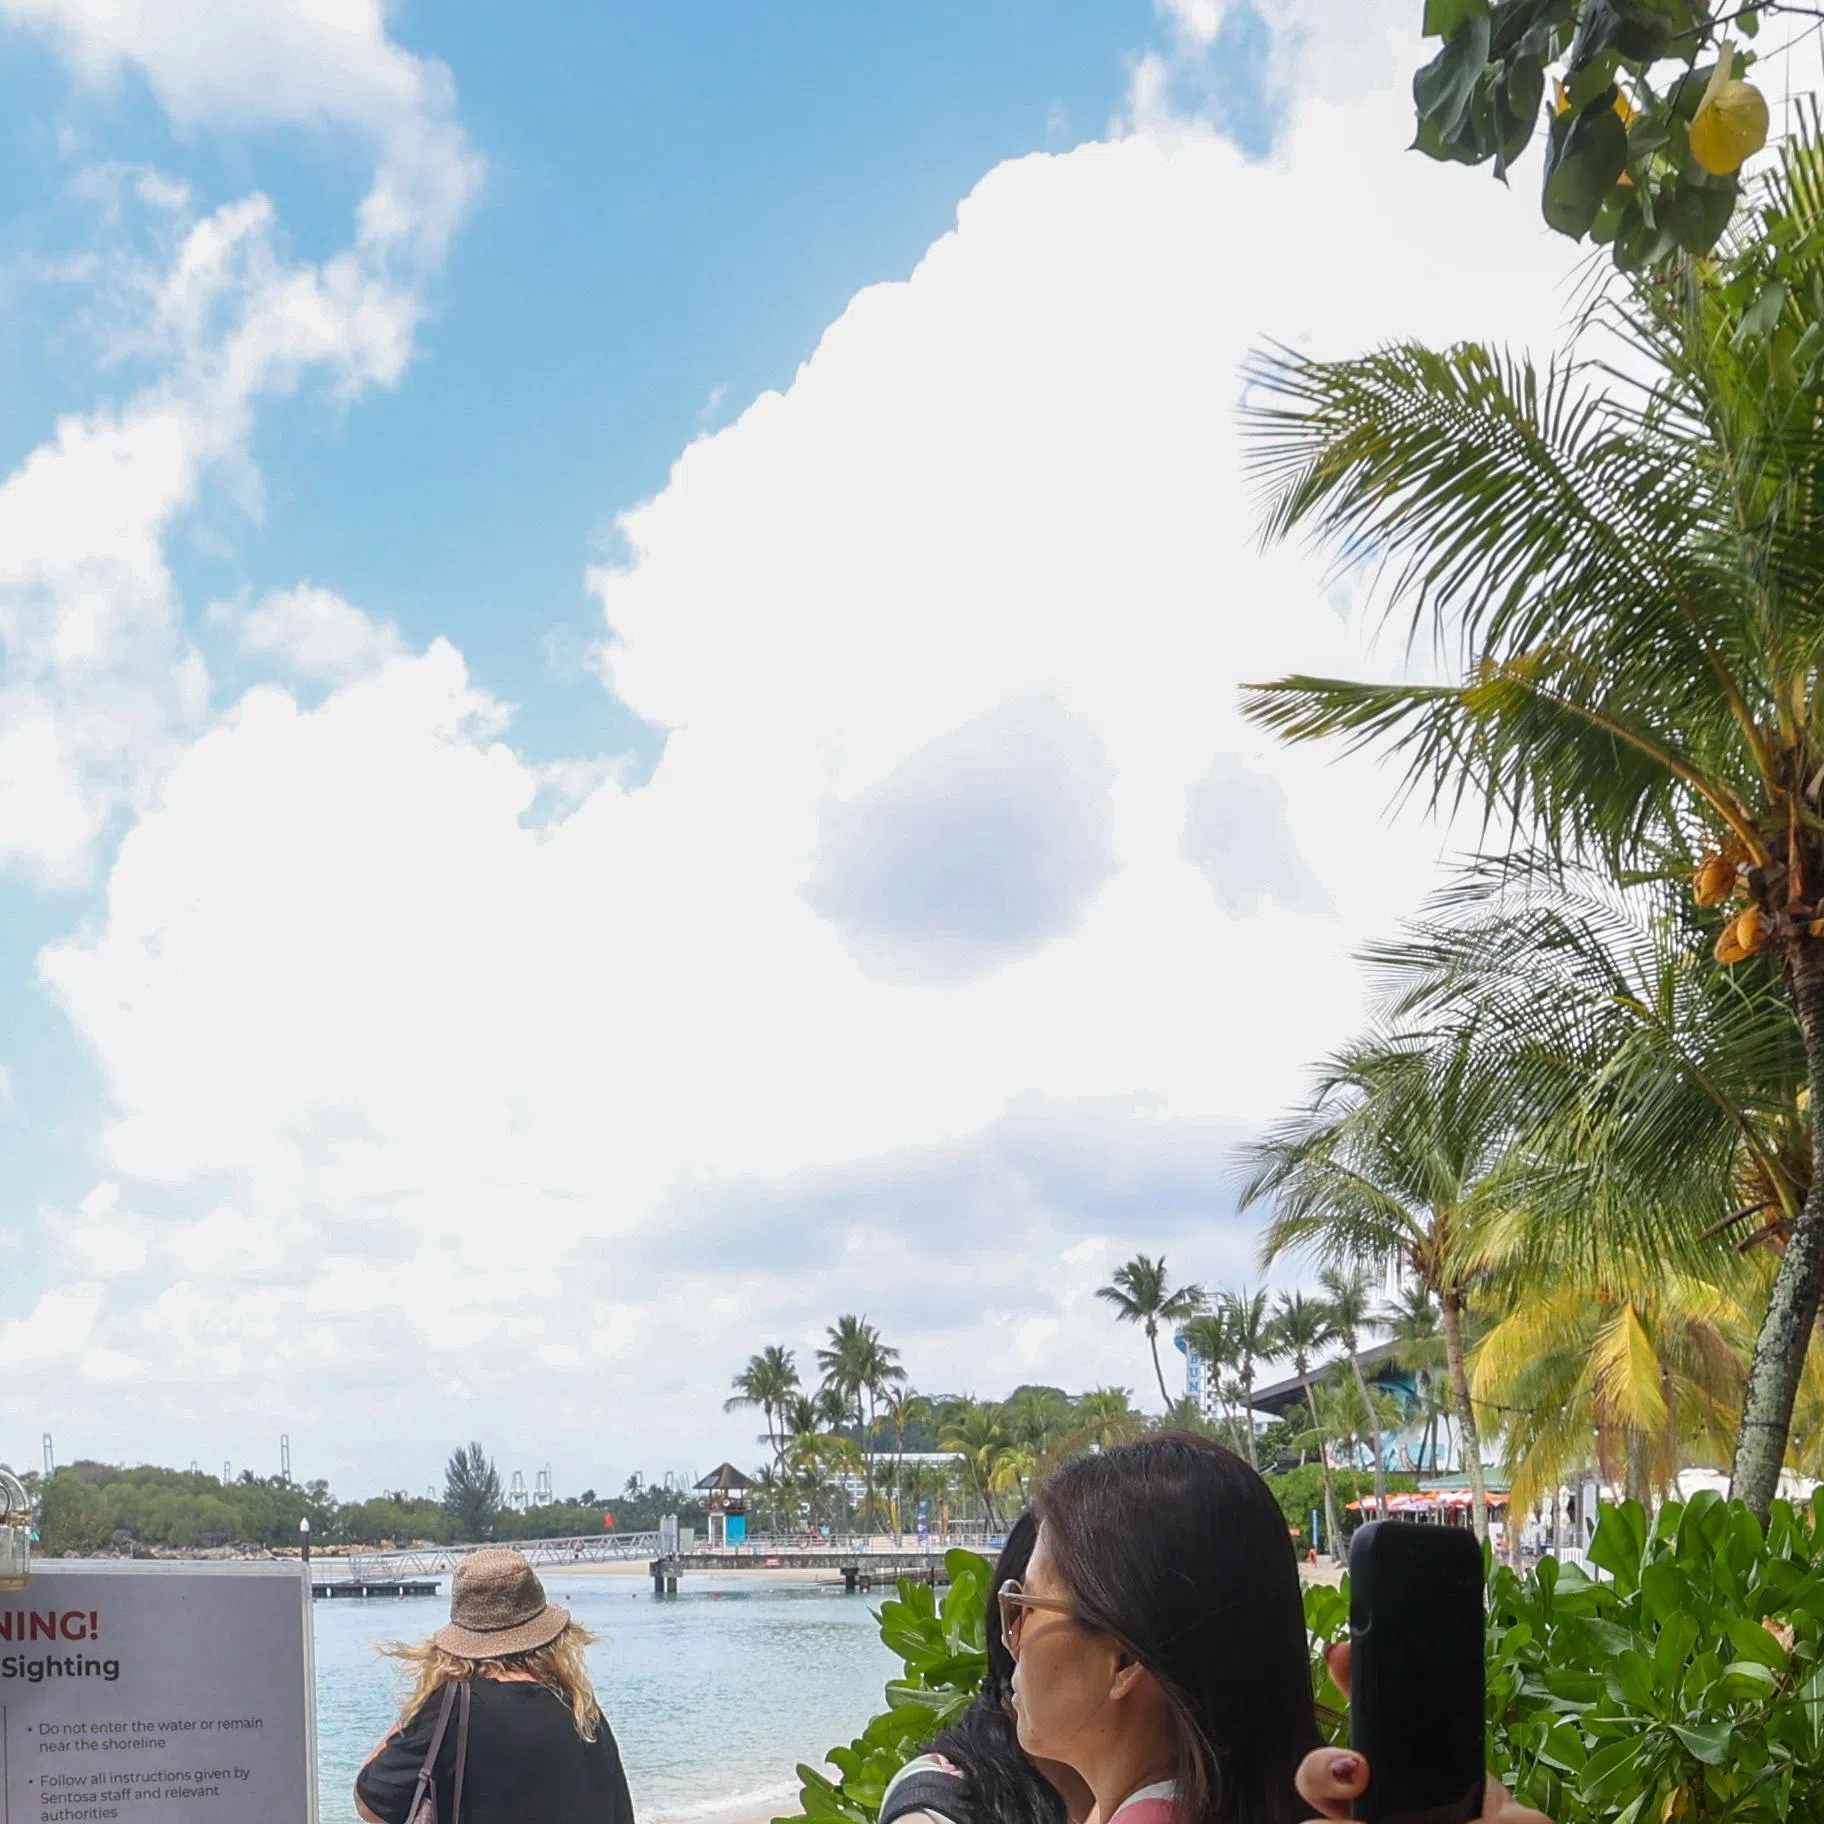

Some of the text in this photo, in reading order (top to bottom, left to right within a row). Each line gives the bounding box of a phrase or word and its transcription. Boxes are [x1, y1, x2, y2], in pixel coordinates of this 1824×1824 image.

[2, 1653, 119, 1683] Sighting
[39, 1719, 263, 1735] Do not enter the water or remain
[39, 1737, 166, 1752] near the shoreline
[40, 1767, 250, 1787] Follow all instructions given by
[40, 1786, 219, 1804] Sentosa staff and relevant
[41, 1806, 118, 1822] authorities
